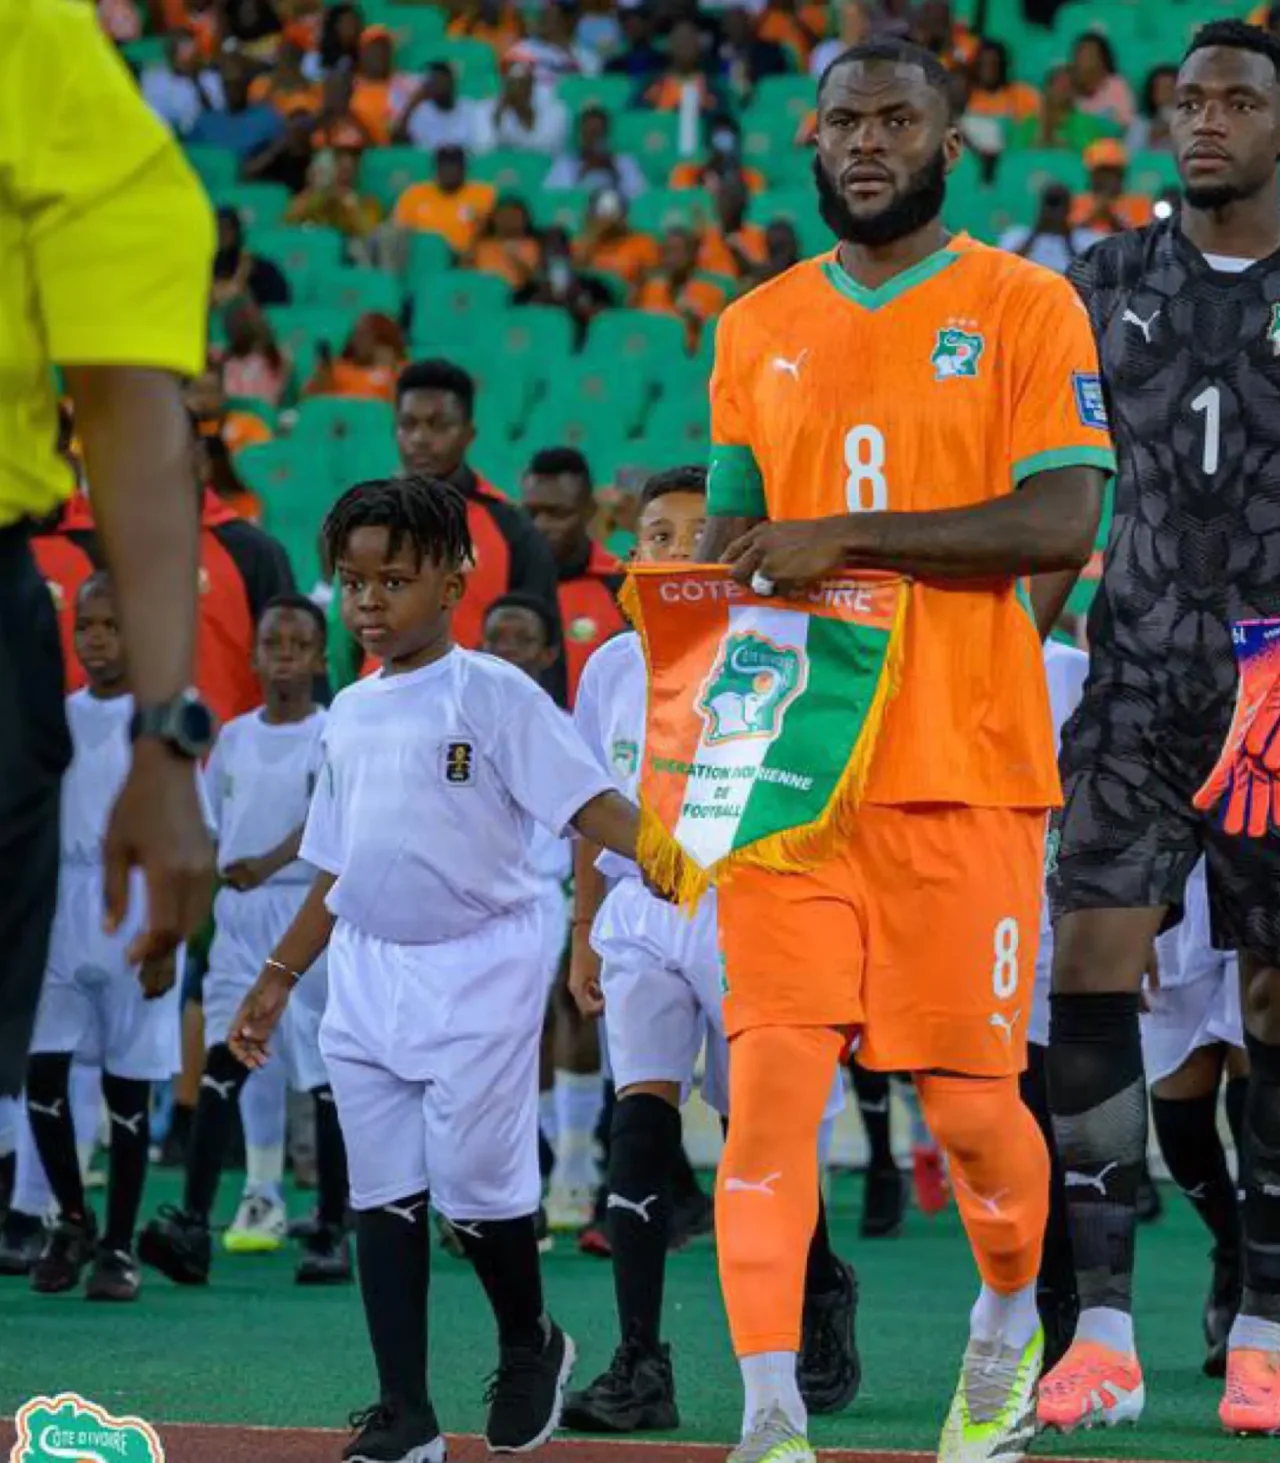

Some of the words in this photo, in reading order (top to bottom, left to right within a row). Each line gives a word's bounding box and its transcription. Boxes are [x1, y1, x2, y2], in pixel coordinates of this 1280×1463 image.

[844, 424, 887, 512] 8
[1191, 386, 1220, 475] 1
[683, 803, 742, 819] FOOTBALL
[992, 916, 1019, 999] 8
